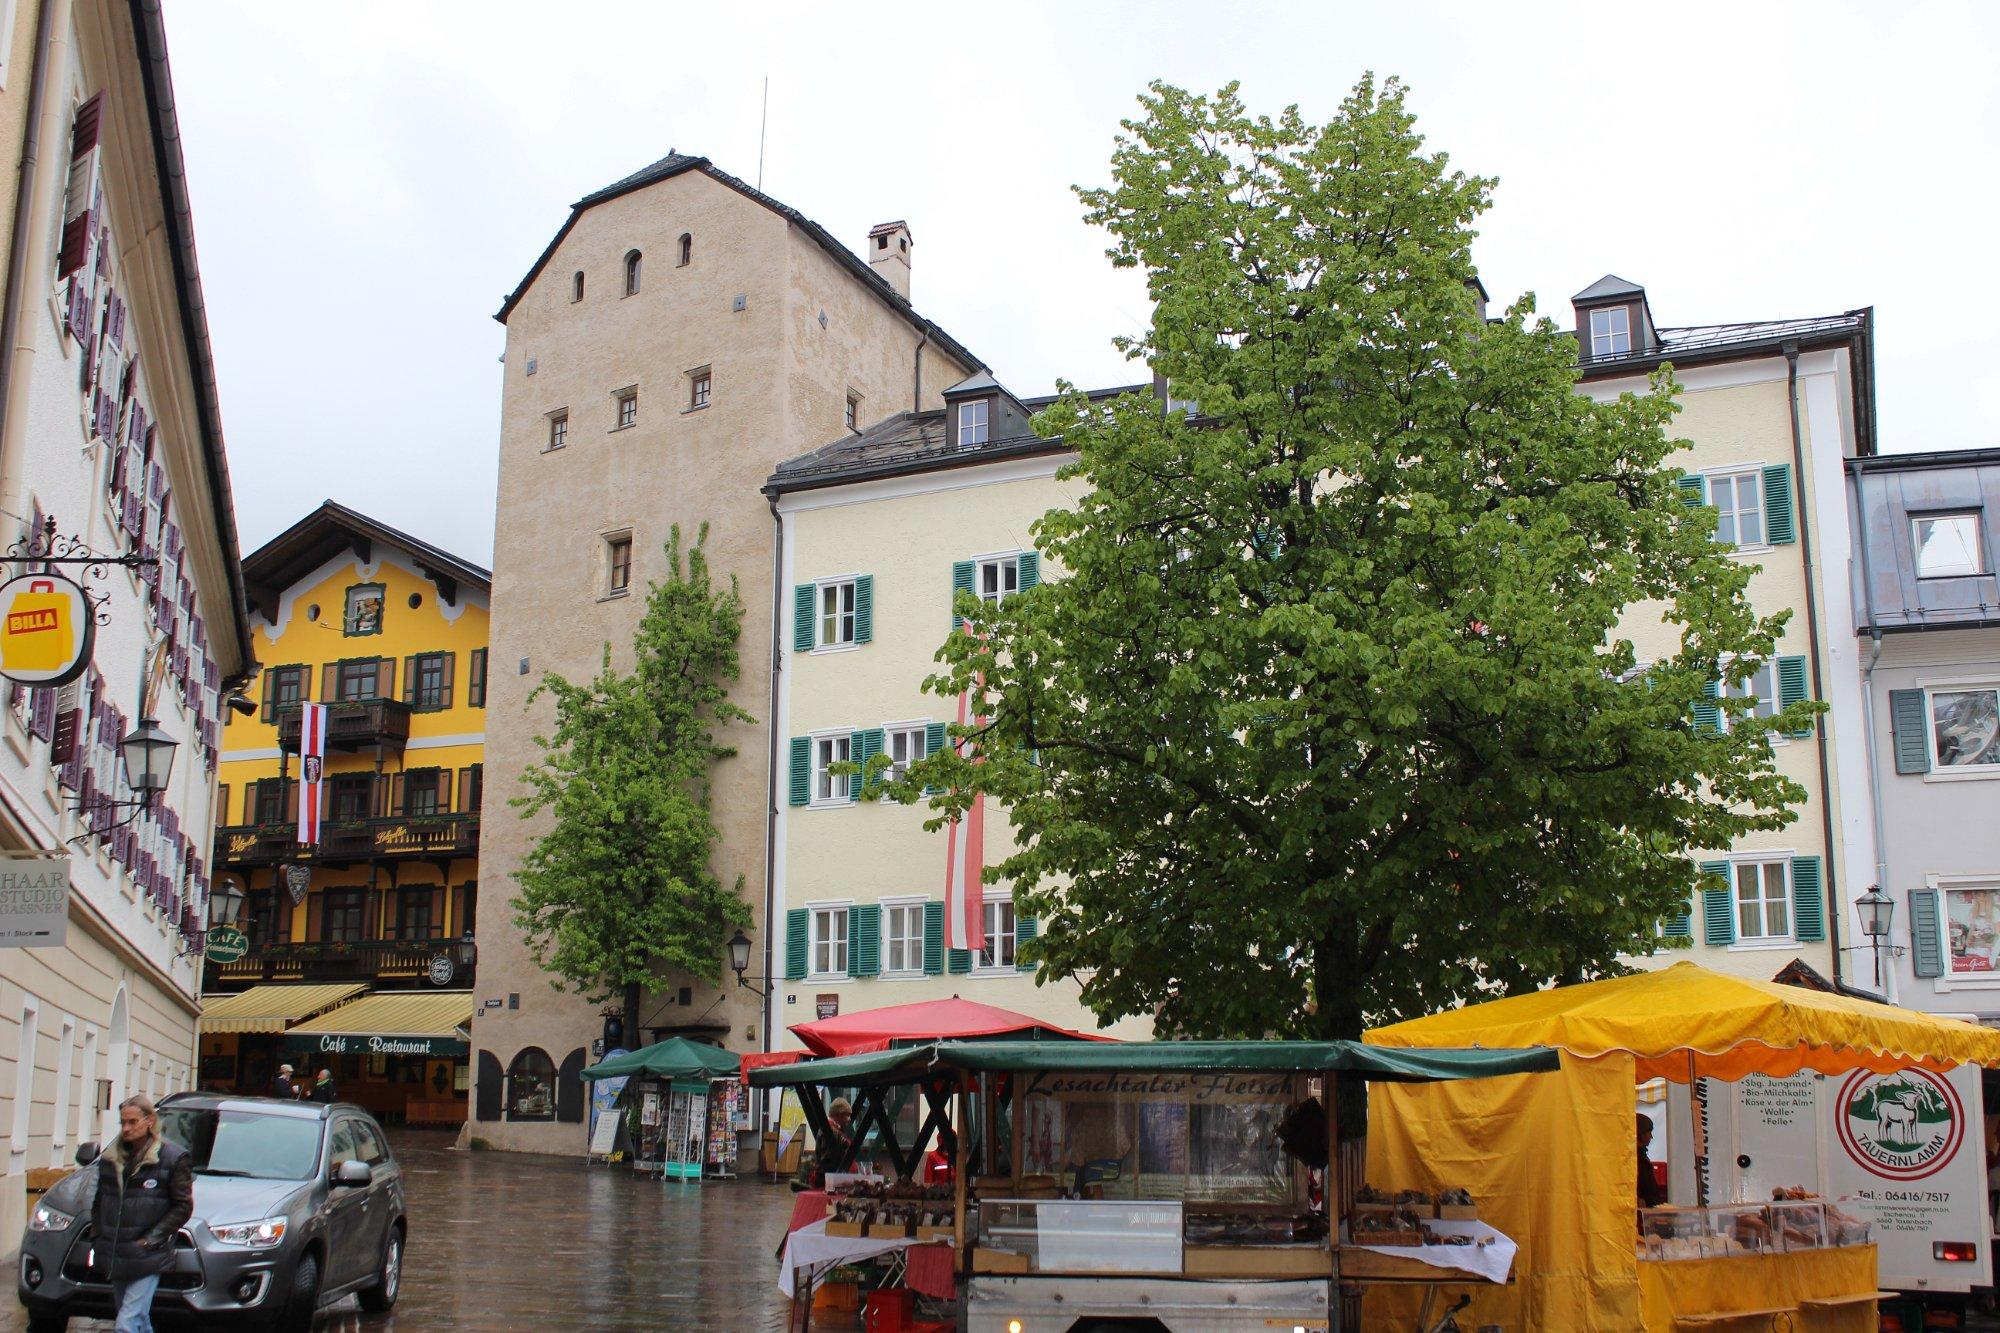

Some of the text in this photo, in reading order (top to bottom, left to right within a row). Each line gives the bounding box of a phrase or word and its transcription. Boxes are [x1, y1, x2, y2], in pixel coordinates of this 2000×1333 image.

[10, 612, 56, 631] BILLA
[1, 872, 64, 889] HAAR
[0, 889, 65, 904] STUDIO
[0, 903, 63, 914] GASSNER
[320, 1035, 347, 1053] Café
[368, 1036, 431, 1054] Restaurant
[1025, 1071, 1293, 1099] Lesachtaler Fleisch
[1745, 1080, 1807, 1089] Sbg. Jungrind
[1746, 1089, 1808, 1097] Bio-Milchkalb
[1792, 1099, 1809, 1107] Alm
[1764, 1108, 1790, 1116] Wolle
[1858, 1133, 1945, 1166] TAUERNLAMM
[1885, 1191, 1950, 1202] 06416/7517
